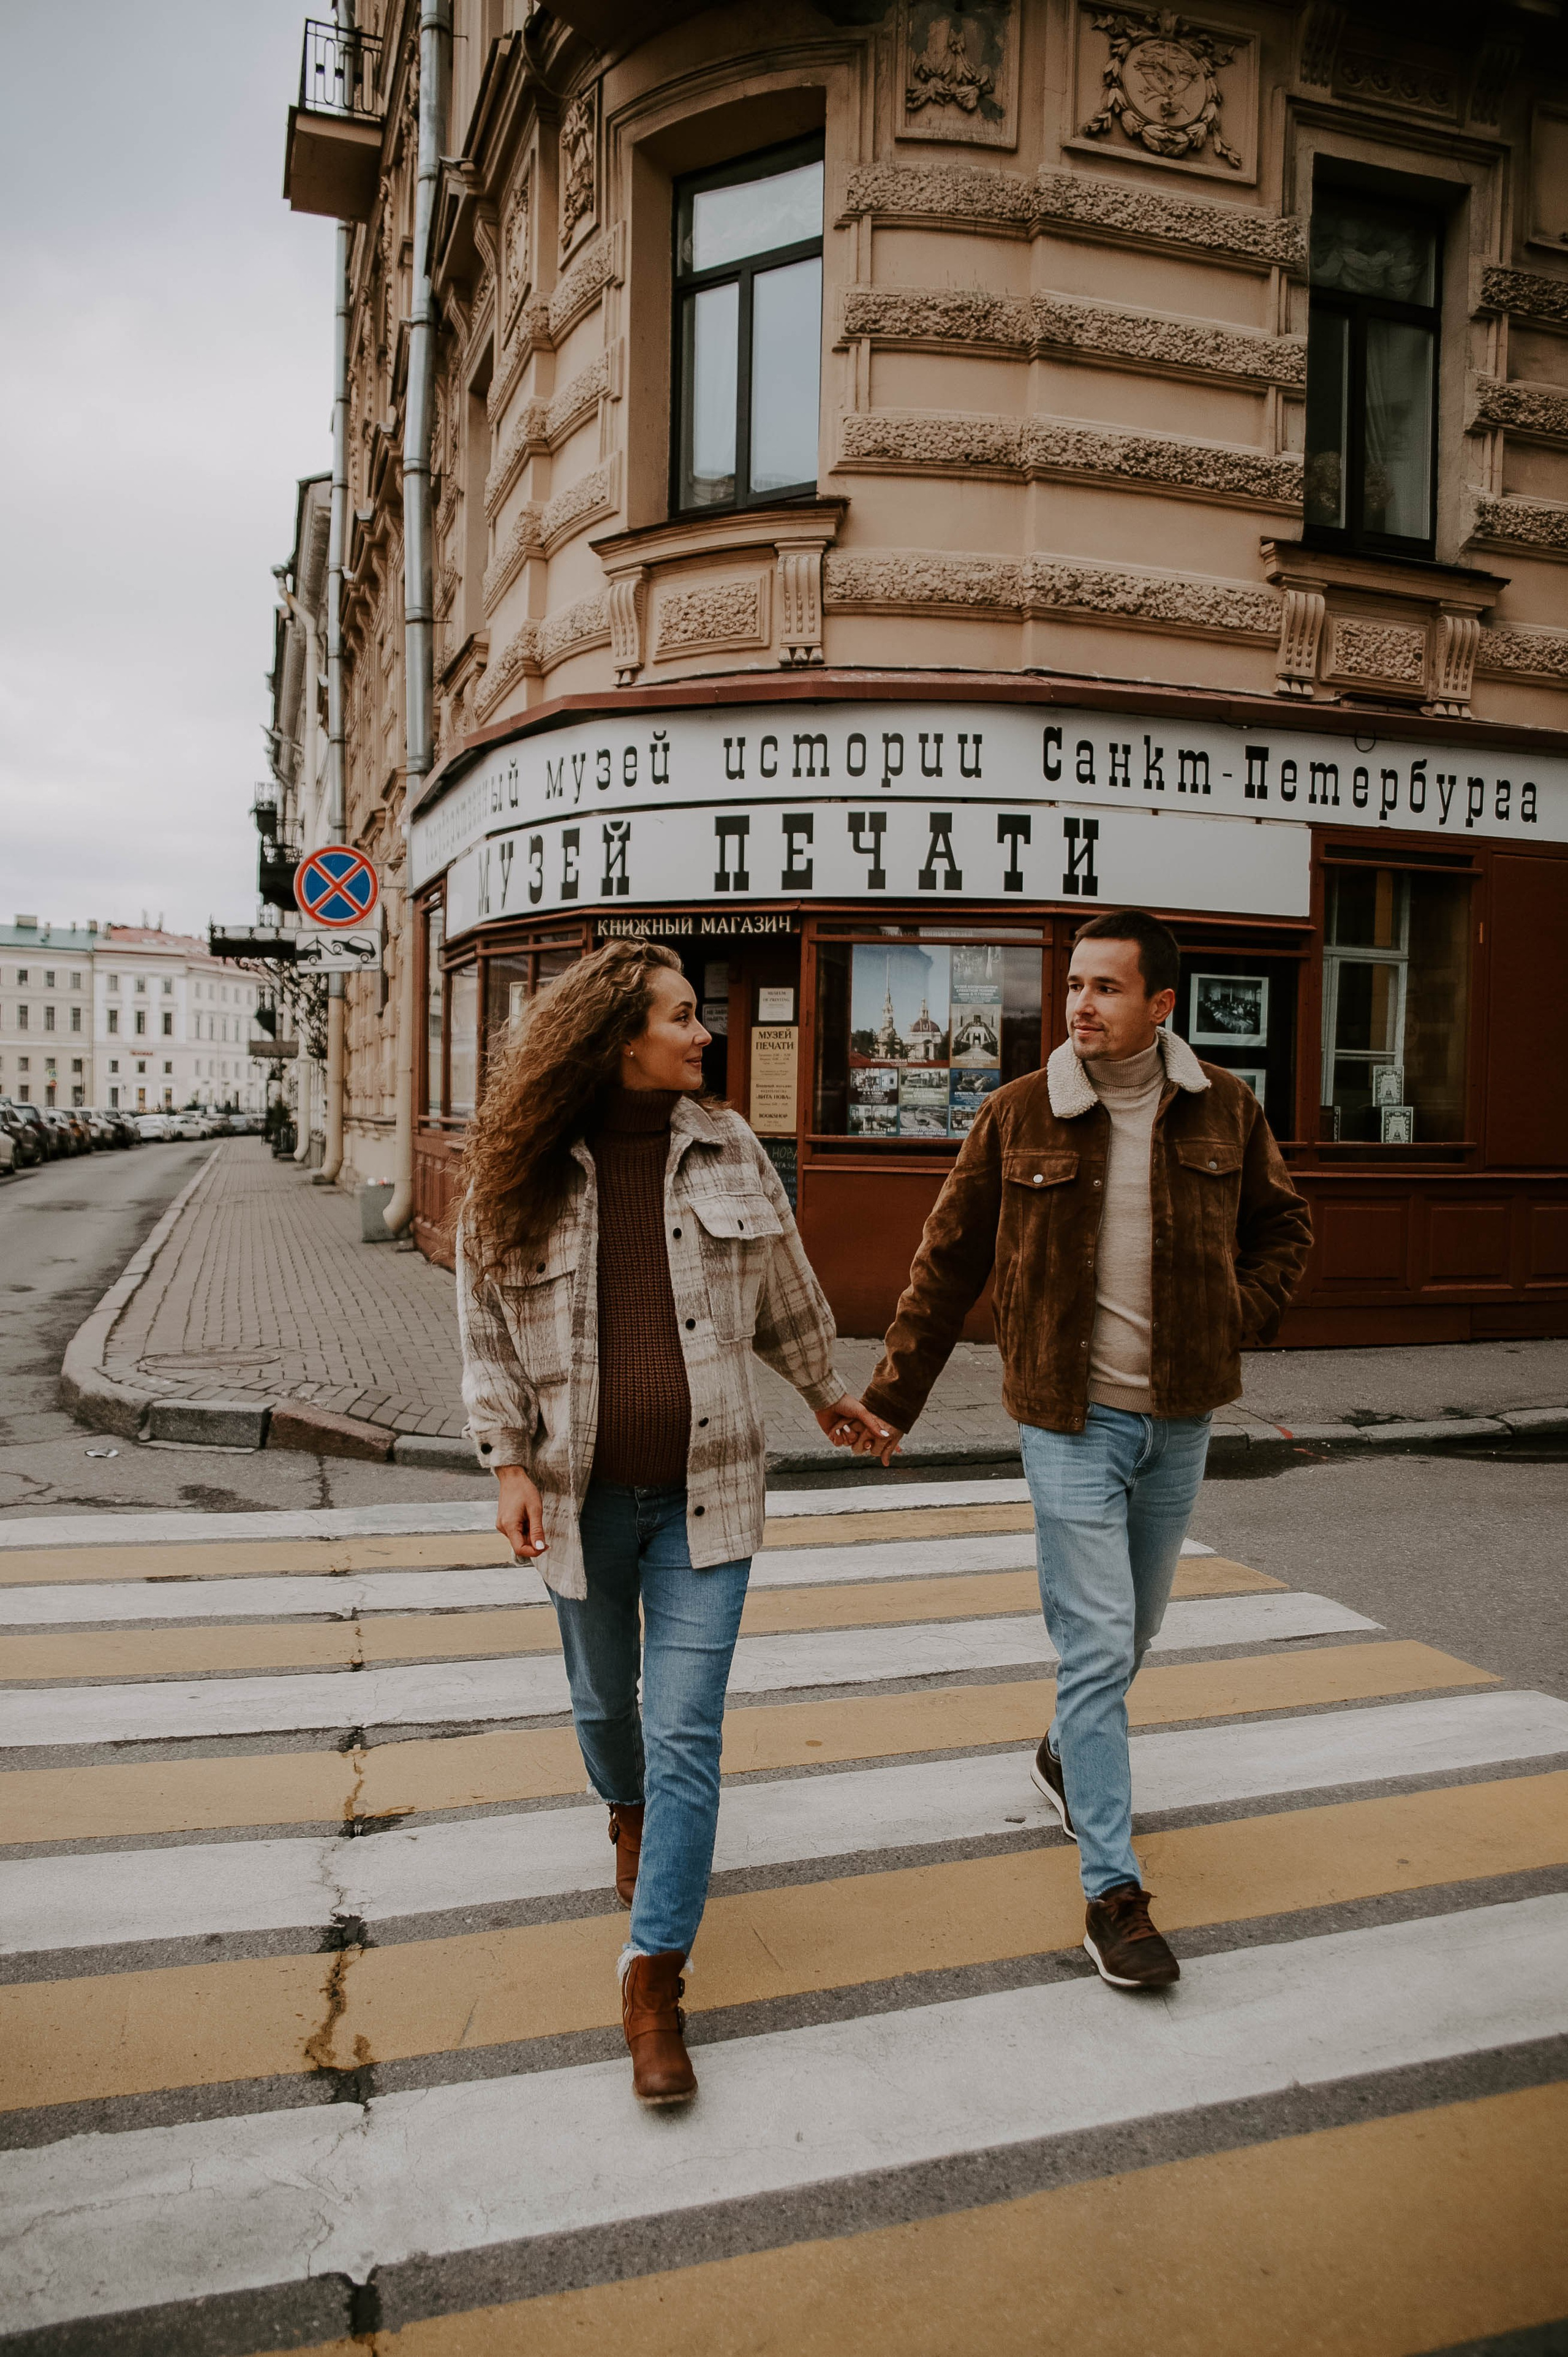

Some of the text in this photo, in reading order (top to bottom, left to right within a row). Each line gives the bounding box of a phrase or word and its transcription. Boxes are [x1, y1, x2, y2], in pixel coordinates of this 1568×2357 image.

[546, 730, 669, 804] музей
[723, 733, 982, 788] истории
[1043, 726, 1538, 828] Санкт-Петербурга
[478, 812, 1099, 916] МУЗЕЙ ПЕЧАТИ
[597, 916, 693, 936] КНИЖНЫЙ
[758, 1027, 791, 1039] МУЗЕЙ
[755, 1042, 794, 1050] ПЕЧАТИ
